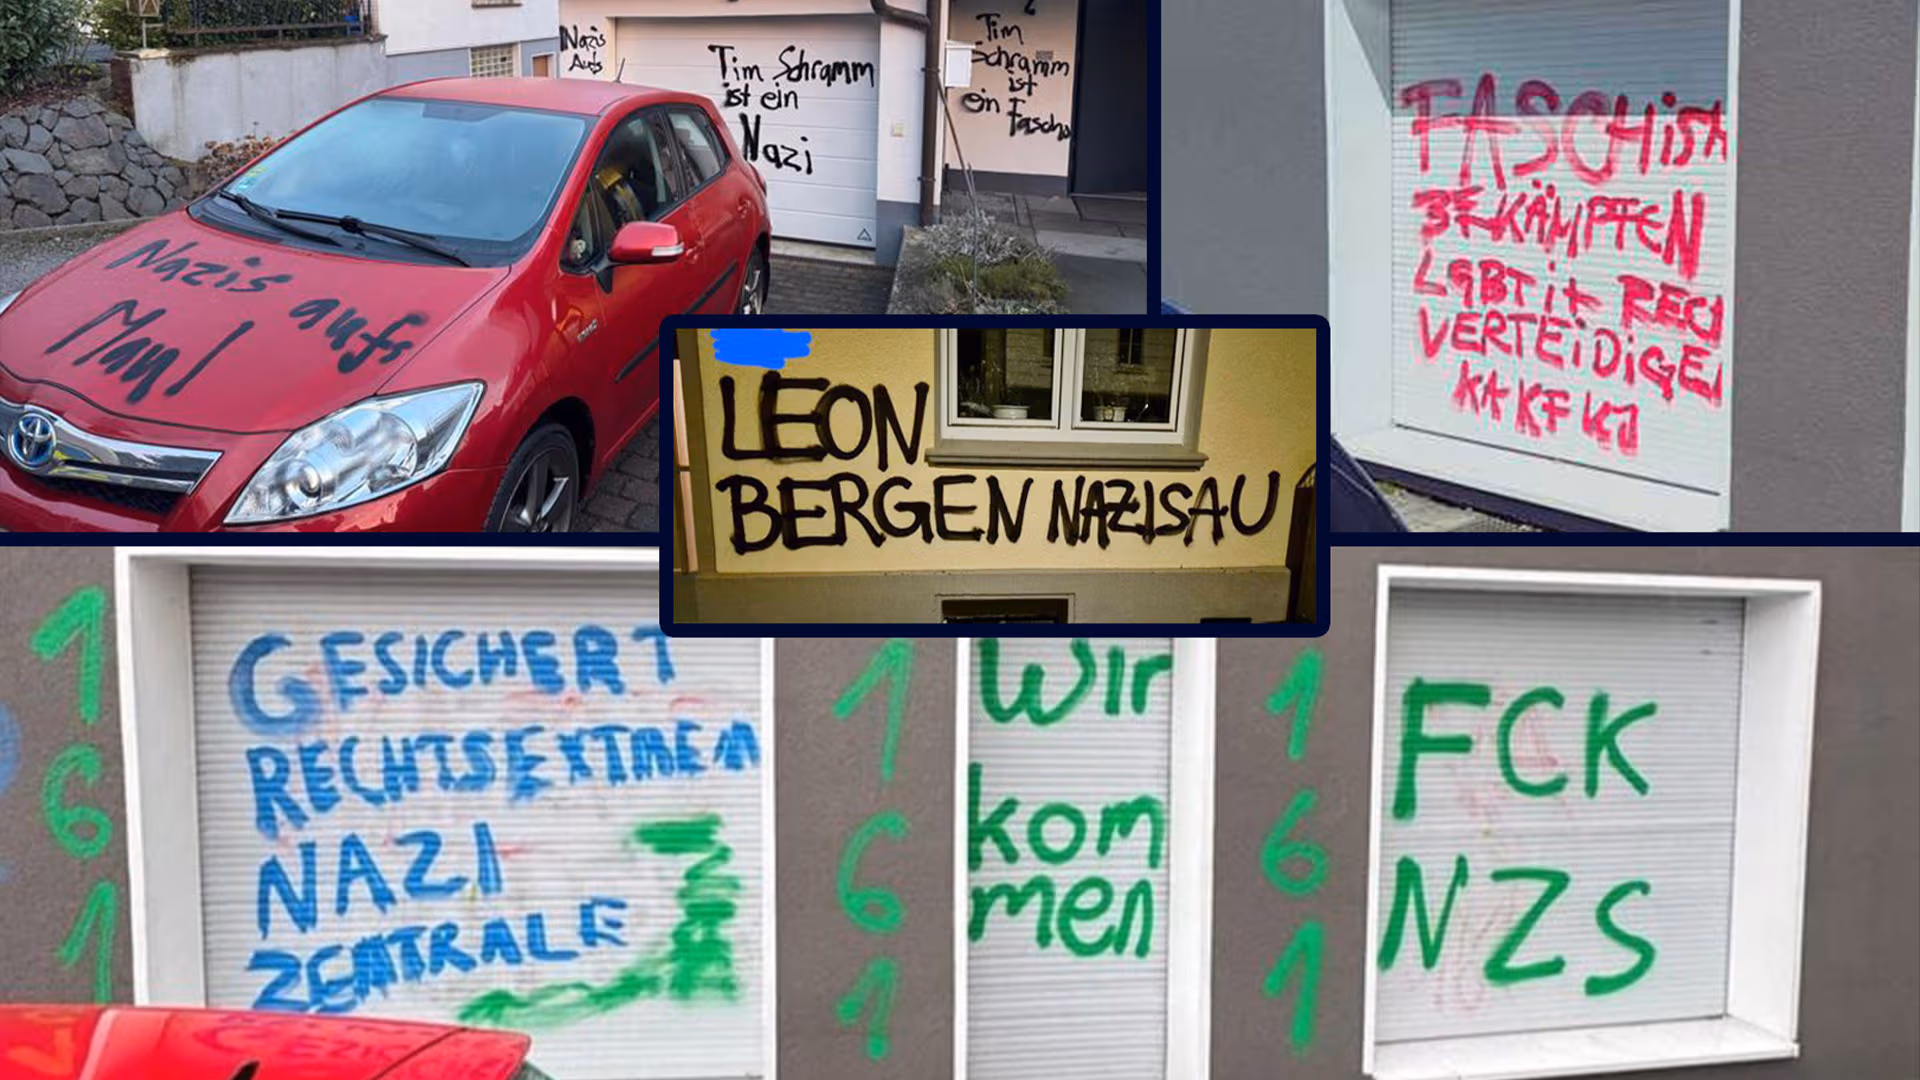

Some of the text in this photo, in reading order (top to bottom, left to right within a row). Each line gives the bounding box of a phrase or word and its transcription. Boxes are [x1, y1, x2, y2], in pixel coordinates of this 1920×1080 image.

[559, 25, 606, 51] Nazis
[708, 44, 875, 87] Tim Schramm
[971, 41, 1070, 77] Schramm
[976, 12, 1024, 45] Tim
[723, 82, 799, 110] ist ein
[1008, 70, 1038, 96] ist
[738, 113, 813, 174] Nazi
[105, 237, 428, 374] Nazis aufs
[718, 371, 930, 471] LEON
[716, 470, 1281, 555] BERGEN NAZISAU
[228, 624, 677, 737] GESICHERT
[978, 638, 1173, 726] Wir
[1393, 676, 1658, 820] FCK
[968, 762, 1165, 870] kom
[258, 821, 503, 938] NAZI
[968, 876, 1154, 958] men
[1377, 855, 1657, 995] NZS
